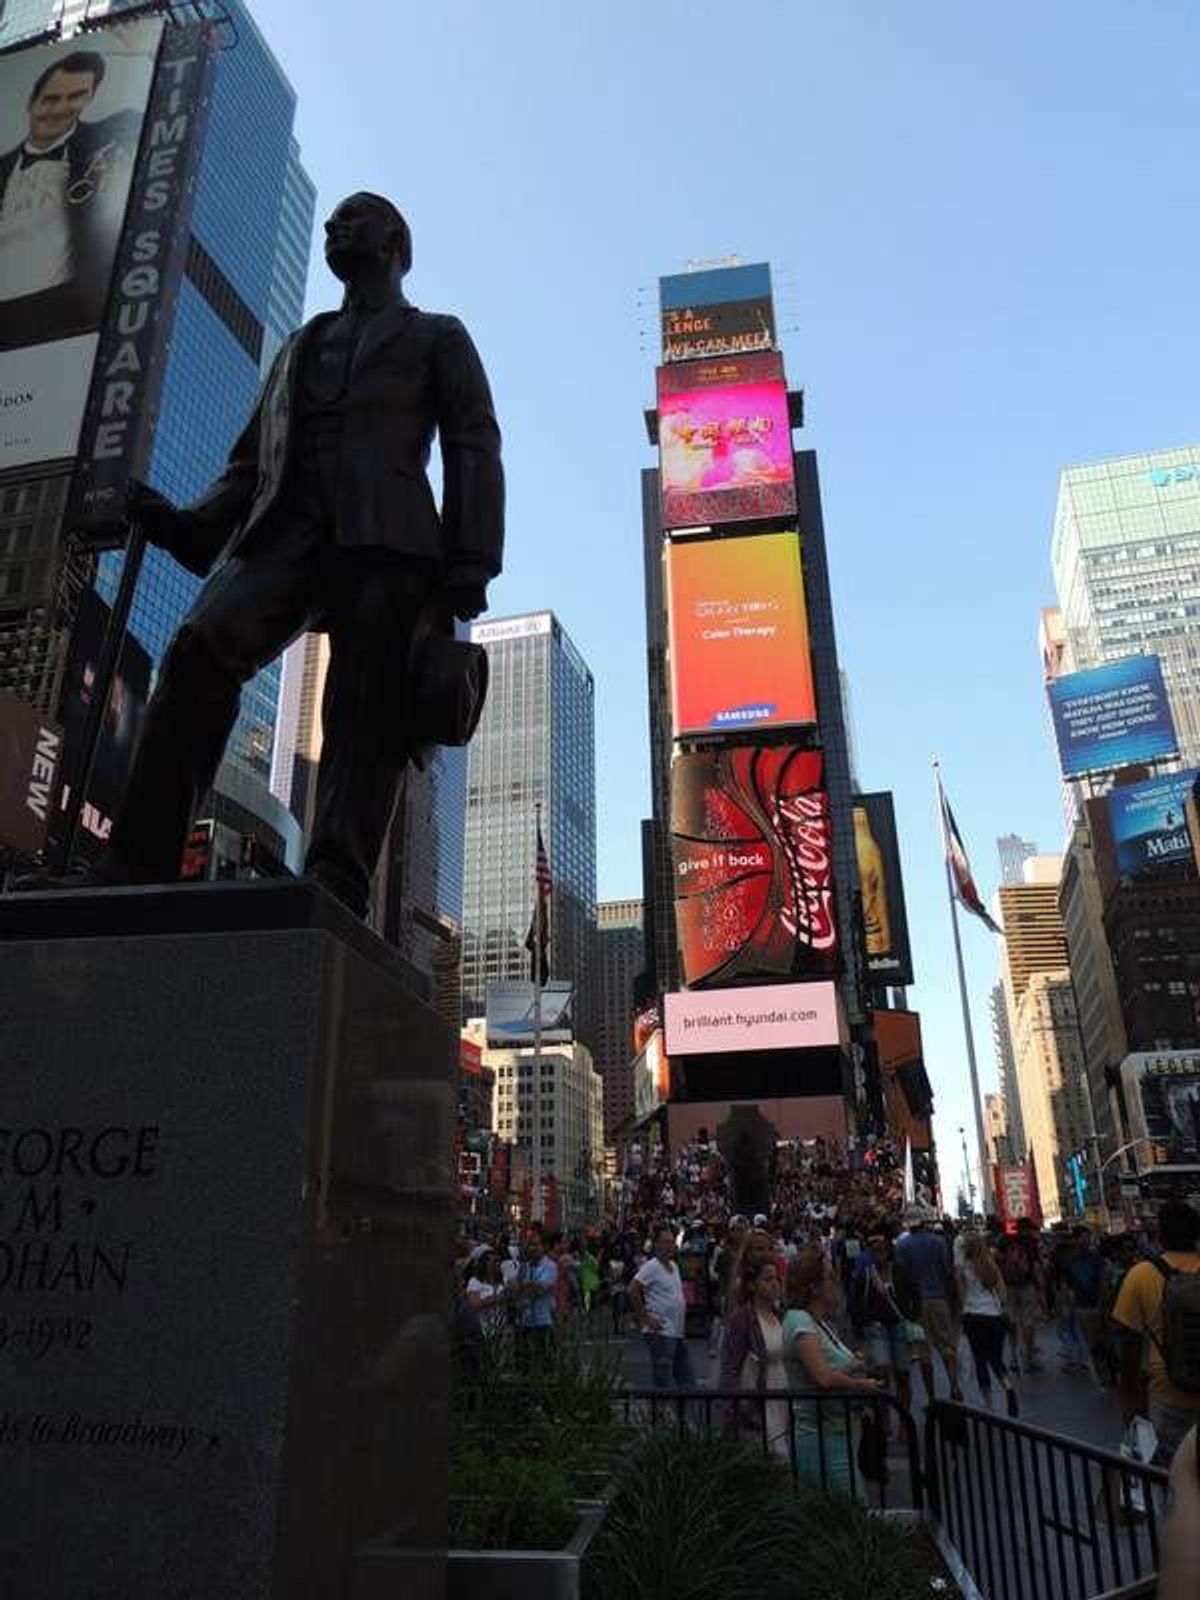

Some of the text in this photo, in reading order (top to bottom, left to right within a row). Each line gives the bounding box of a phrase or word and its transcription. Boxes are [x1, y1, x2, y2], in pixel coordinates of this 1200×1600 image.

[93, 55, 197, 460] TIMES SQUARE
[716, 708, 770, 721] SAMSUNG
[27, 727, 61, 821] NEW
[678, 852, 764, 875] give it back
[683, 1009, 818, 1029] brilliant.hyundai.com
[15, 1184, 63, 1234] M
[63, 1411, 192, 1459] Broadway
